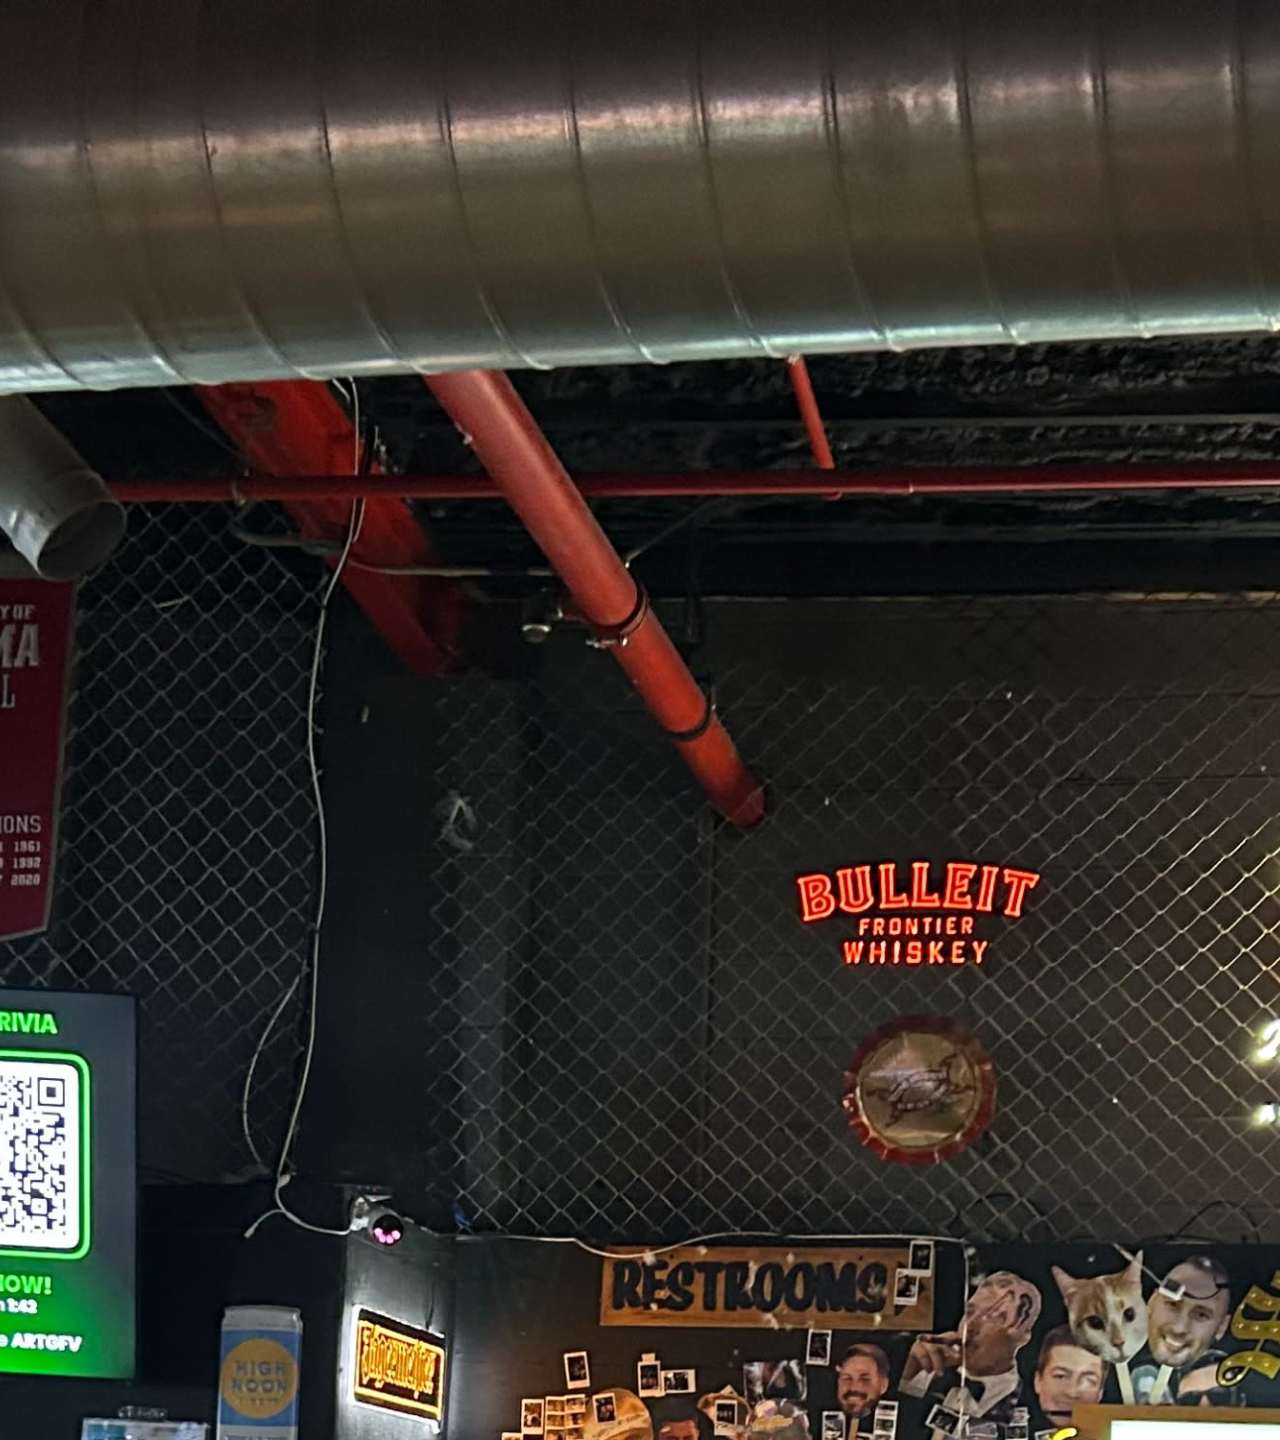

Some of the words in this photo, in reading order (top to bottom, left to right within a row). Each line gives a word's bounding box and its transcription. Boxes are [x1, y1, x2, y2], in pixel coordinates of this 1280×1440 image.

[13, 605, 35, 620] OF
[797, 862, 1040, 922] BULLEIT
[859, 916, 974, 936] FRONTIER
[843, 941, 989, 965] WHISKEY
[612, 1259, 889, 1314] RESTROOMS
[235, 1361, 287, 1377] HIGH
[231, 1378, 287, 1394] NOON
